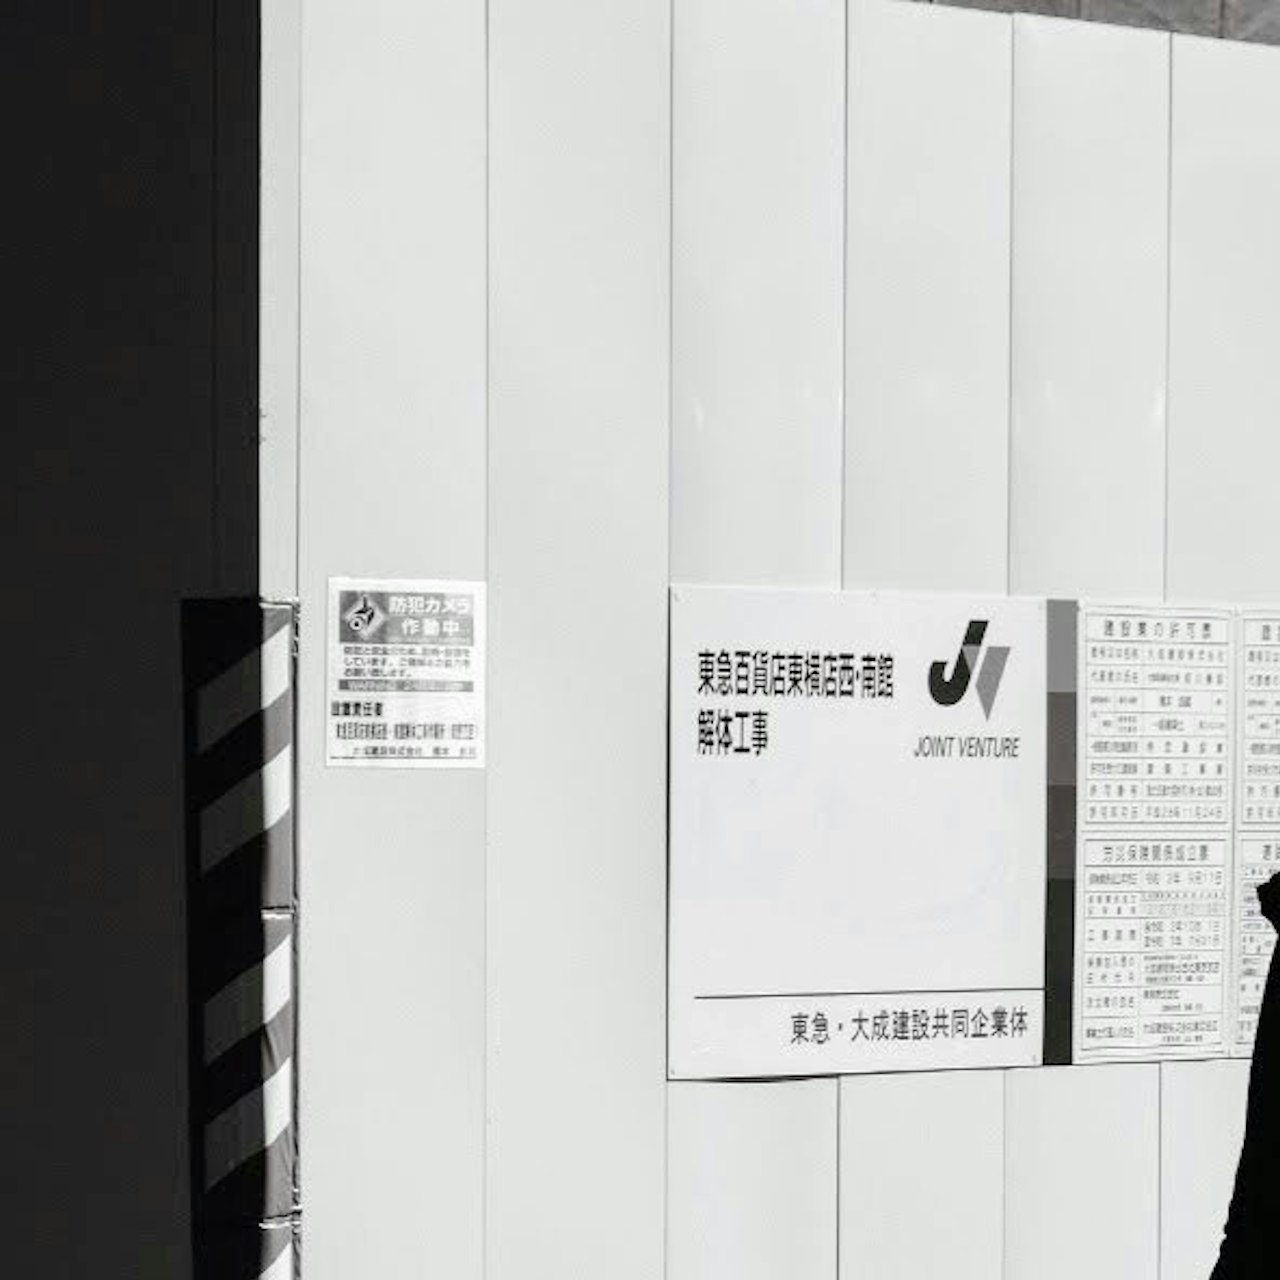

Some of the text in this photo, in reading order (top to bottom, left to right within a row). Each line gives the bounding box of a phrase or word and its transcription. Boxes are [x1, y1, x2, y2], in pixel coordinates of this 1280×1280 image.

[388, 596, 470, 615] 防犯カメラ
[401, 618, 460, 637] 作動中
[698, 648, 894, 698] 東急百貨店東横店西・南館
[698, 709, 769, 756] 解体工事
[914, 736, 1020, 758] JOINT VENTURE
[790, 1006, 1028, 1044] 東急・大成建設共同企業体
